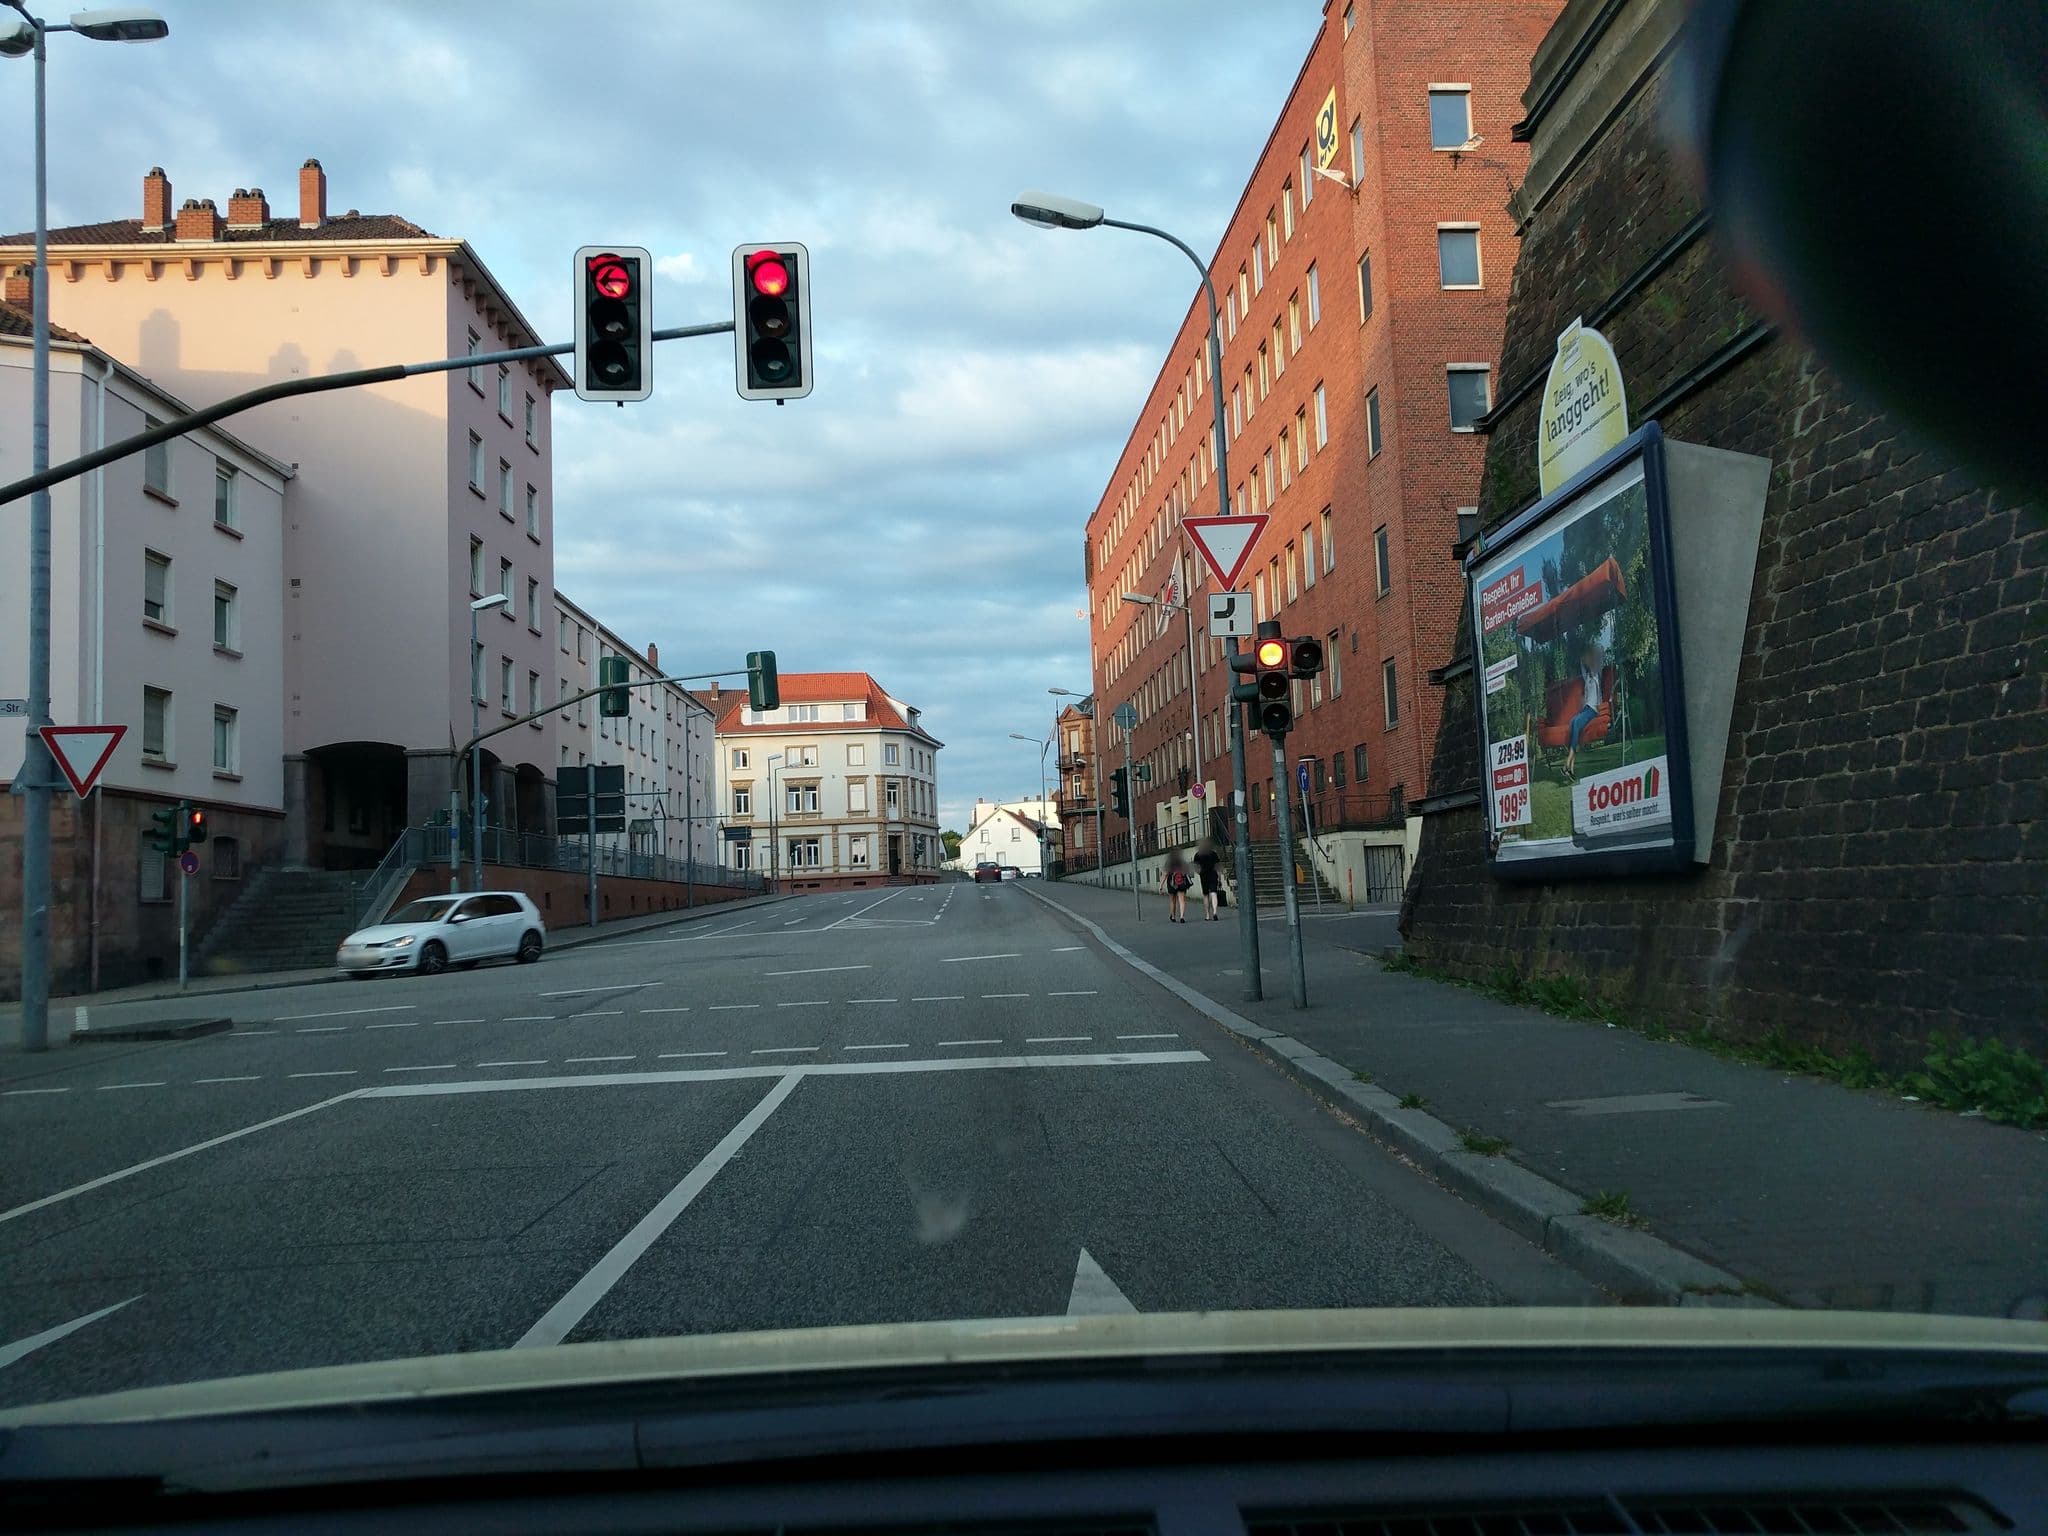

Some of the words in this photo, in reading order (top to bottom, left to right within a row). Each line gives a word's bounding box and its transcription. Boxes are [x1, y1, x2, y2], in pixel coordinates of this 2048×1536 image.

[1575, 360, 1597, 387] wo's
[1545, 367, 1611, 443] langgeht!
[1482, 581, 1510, 607] Respekt,
[1510, 573, 1520, 589] Ihr
[1483, 591, 1538, 631] Garten-Genießer.
[1588, 776, 1642, 812] toom
